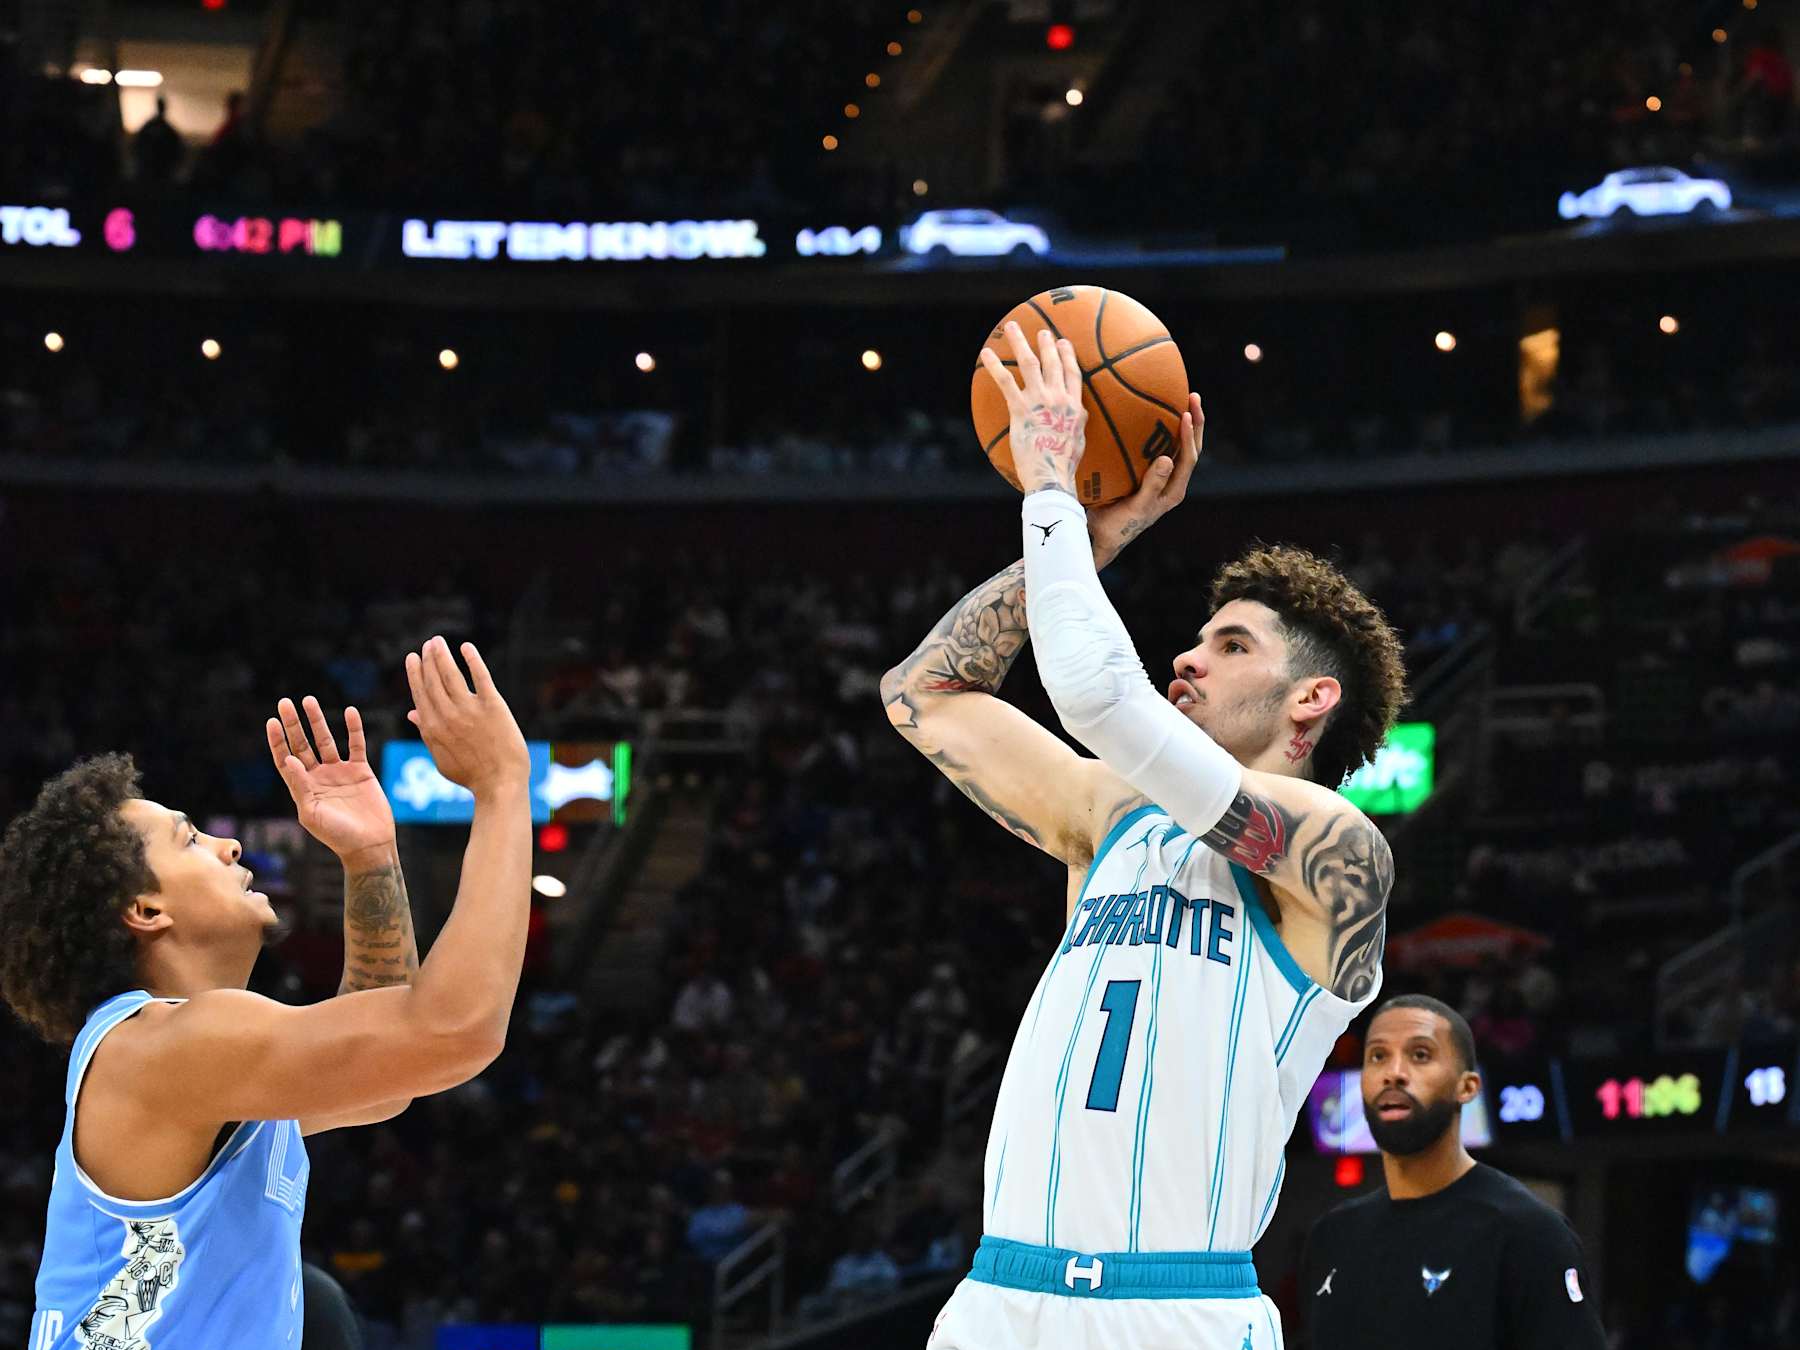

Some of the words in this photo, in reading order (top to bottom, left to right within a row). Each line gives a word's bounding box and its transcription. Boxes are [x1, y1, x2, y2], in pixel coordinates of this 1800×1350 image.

[104, 207, 135, 251] 6
[1063, 885, 1234, 966] CHAROTTE
[1085, 980, 1141, 1112] 1
